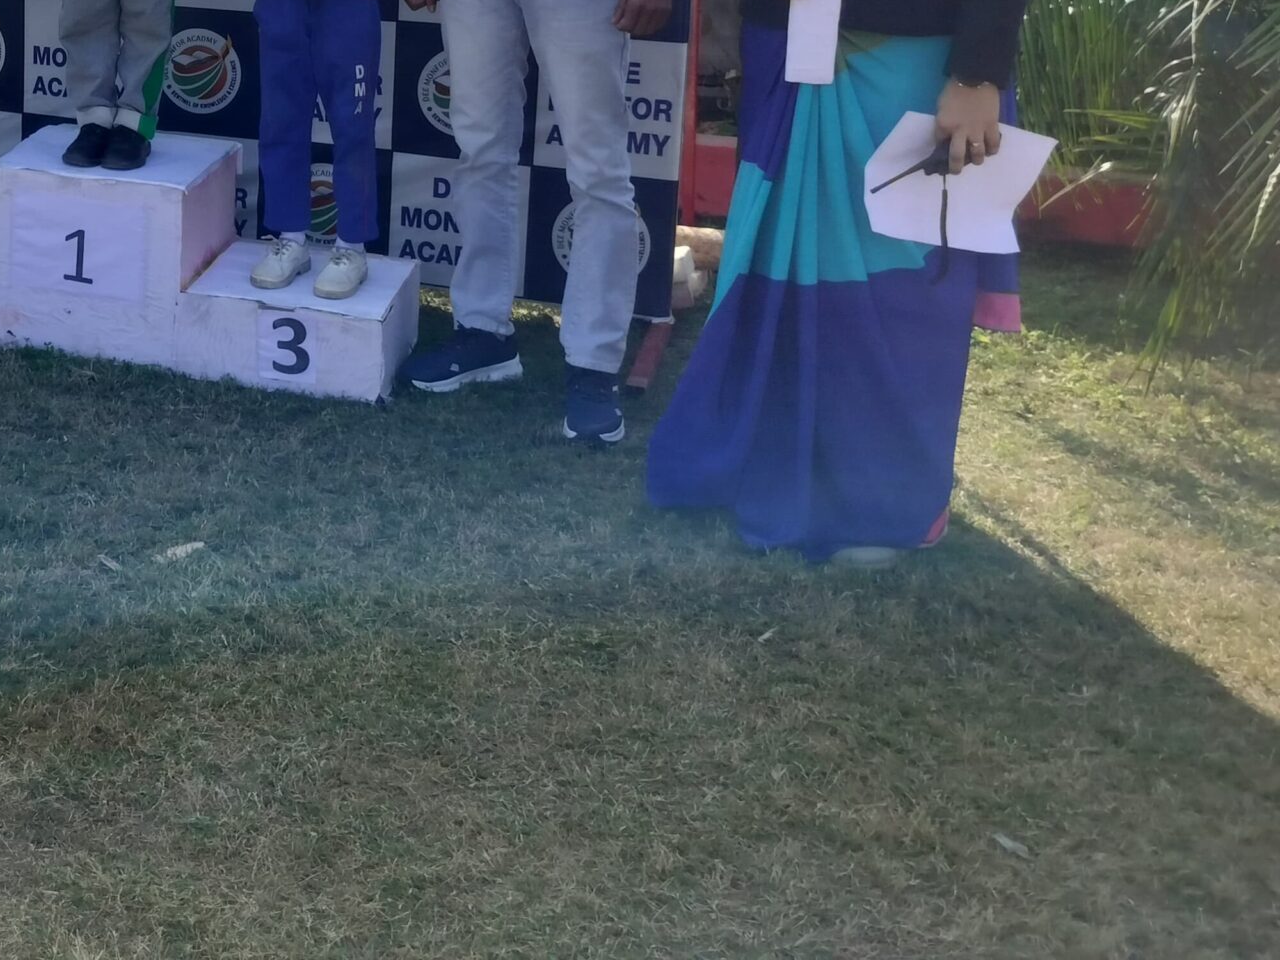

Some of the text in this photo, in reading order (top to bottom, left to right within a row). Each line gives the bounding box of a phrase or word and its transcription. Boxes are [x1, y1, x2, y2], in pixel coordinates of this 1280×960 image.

[401, 206, 460, 233] MON
[63, 229, 93, 285] 1
[271, 317, 311, 375] 3
